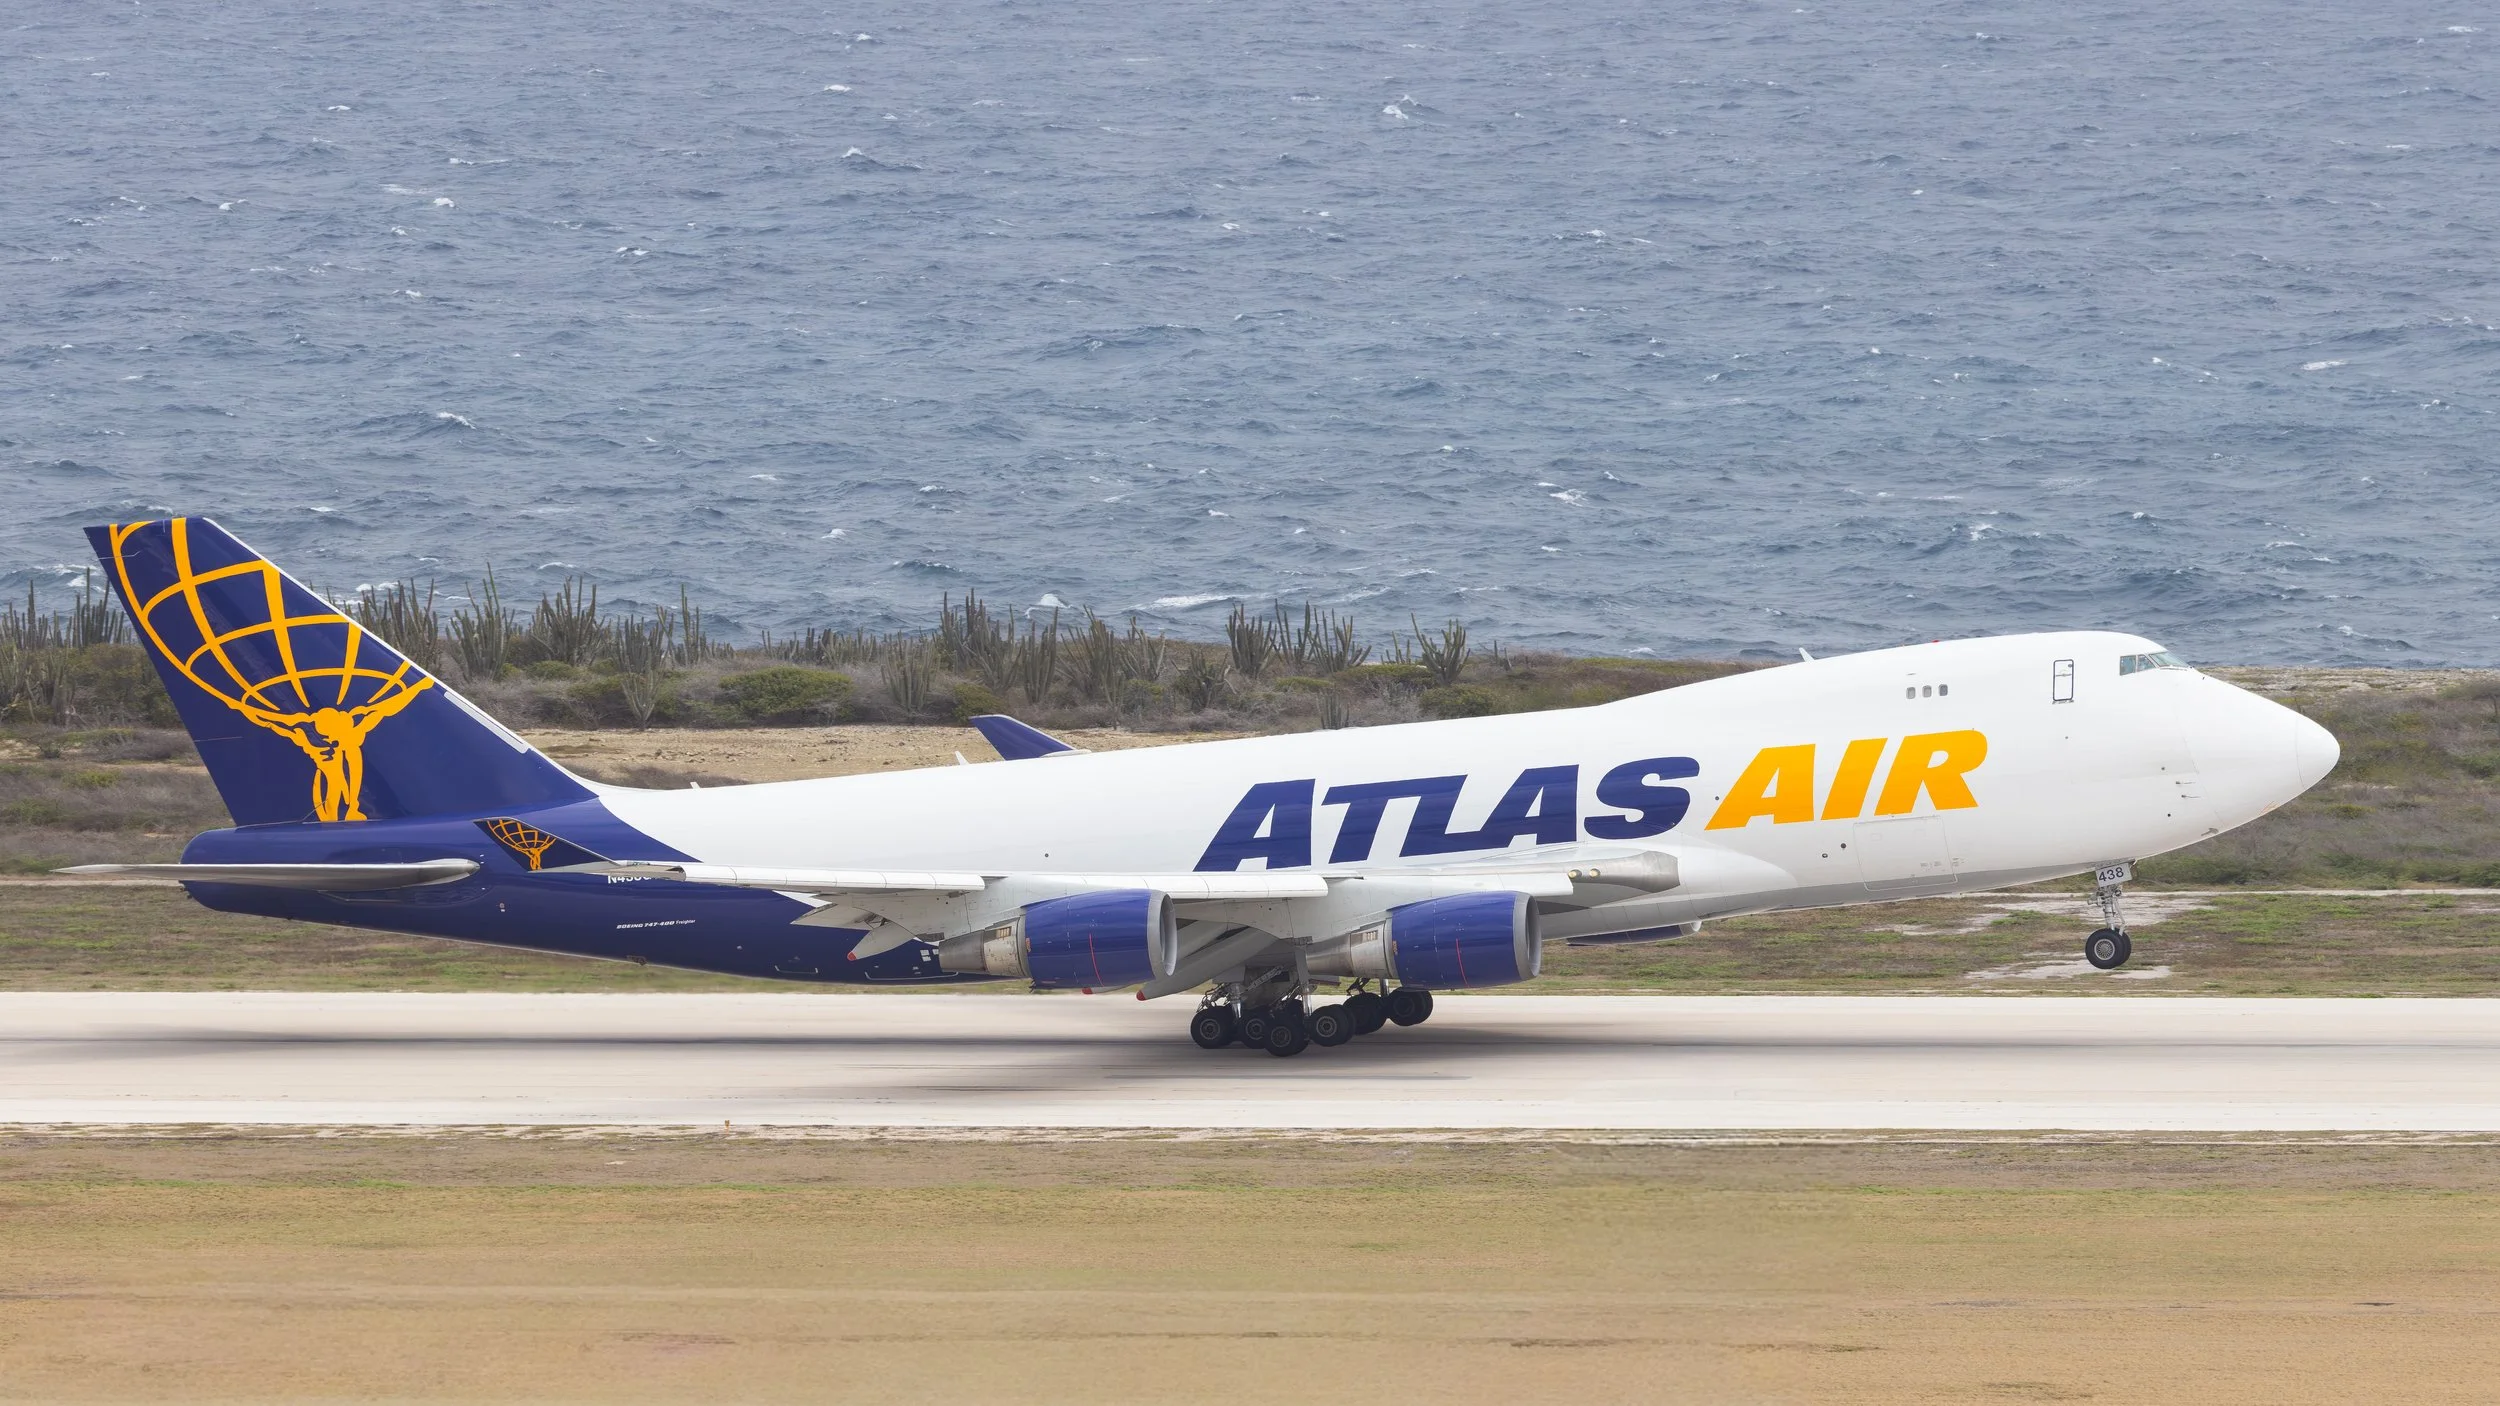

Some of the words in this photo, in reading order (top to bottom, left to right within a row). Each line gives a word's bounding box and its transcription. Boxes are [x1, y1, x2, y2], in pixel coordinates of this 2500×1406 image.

[1194, 757, 1700, 872] ATLAS
[1705, 729, 1988, 830] AIR
[2099, 866, 2124, 881] 438
